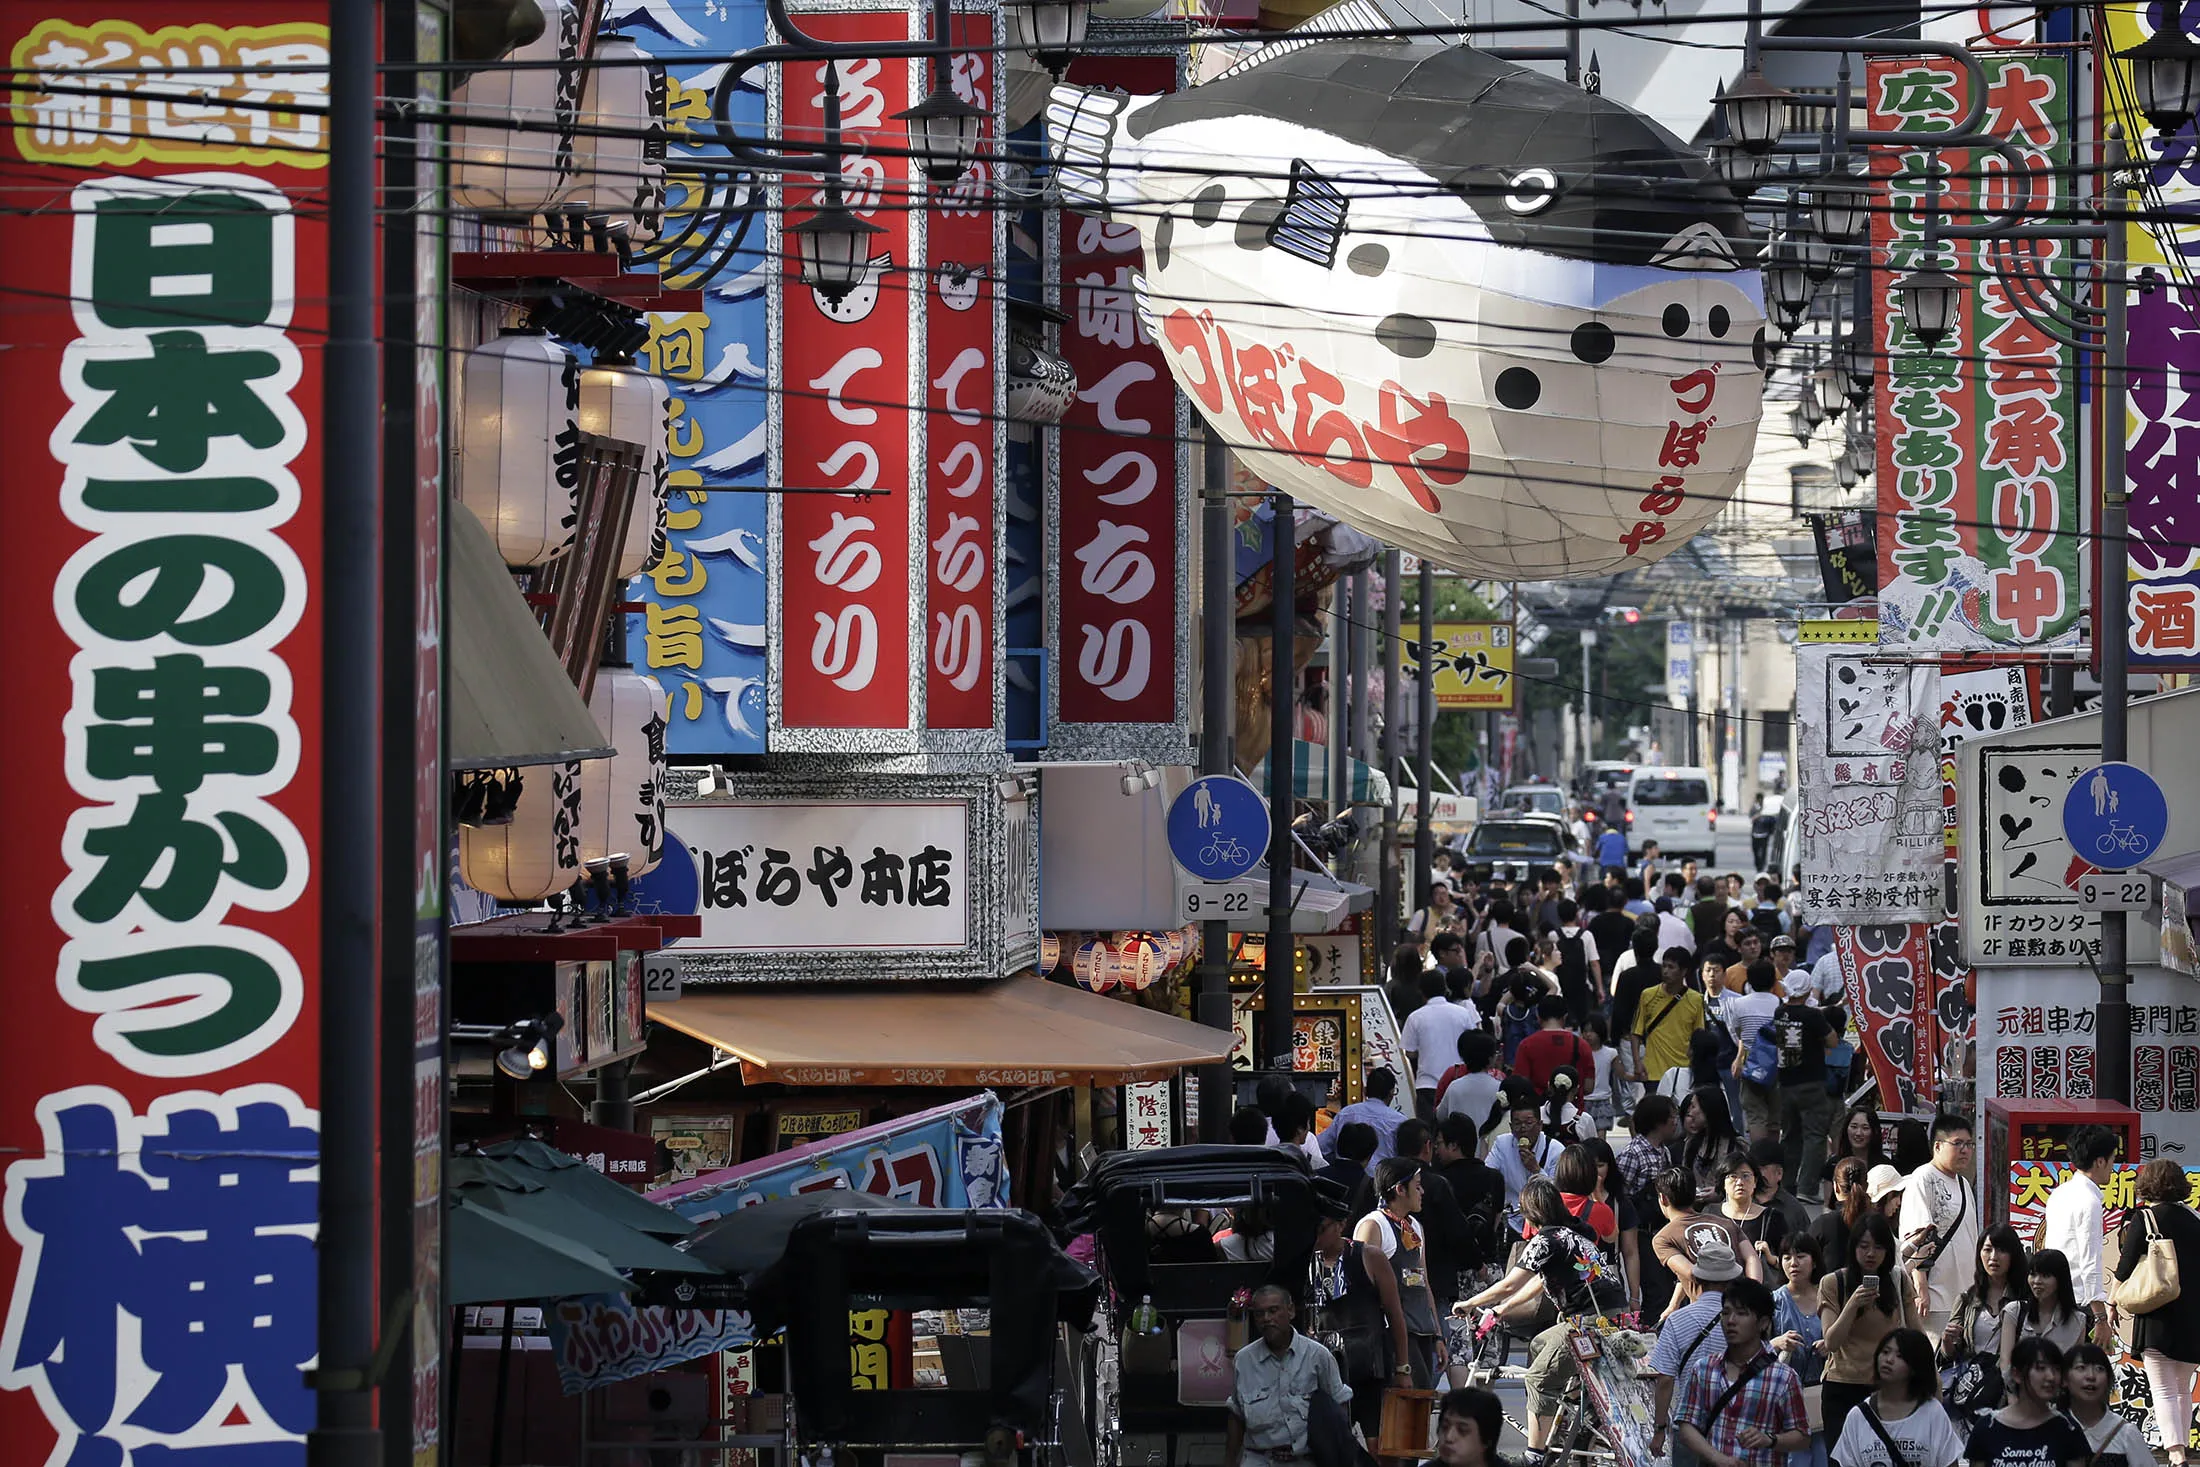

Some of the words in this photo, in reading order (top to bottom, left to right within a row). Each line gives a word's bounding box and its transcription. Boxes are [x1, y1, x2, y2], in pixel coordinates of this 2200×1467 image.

[33, 40, 330, 147] 新世界
[1163, 307, 1471, 514] づぼらや
[1619, 361, 1722, 556] づぼらや
[809, 347, 883, 691] てっちり
[933, 347, 985, 691] てっちり
[65, 187, 298, 1066] 日本一の串かつ
[2135, 591, 2195, 649] 酒
[1803, 791, 1898, 838] 大阪名物
[690, 845, 953, 909] ぼらや本店
[1808, 885, 1940, 909] 宴会予約受付中
[1983, 939, 2003, 956] 2F
[1984, 915, 2003, 931] 1F
[646, 967, 676, 992] 22
[1996, 1005, 2198, 1035] 元祖串カ専門店
[1999, 1048, 2026, 1099] 大阪名
[2068, 1048, 2095, 1099] どて焼
[2136, 1048, 2164, 1111] たこ焼き
[2171, 1048, 2198, 1111] 味自慢
[2001, 1447, 2034, 1458] Some
[2035, 1444, 2049, 1460] of
